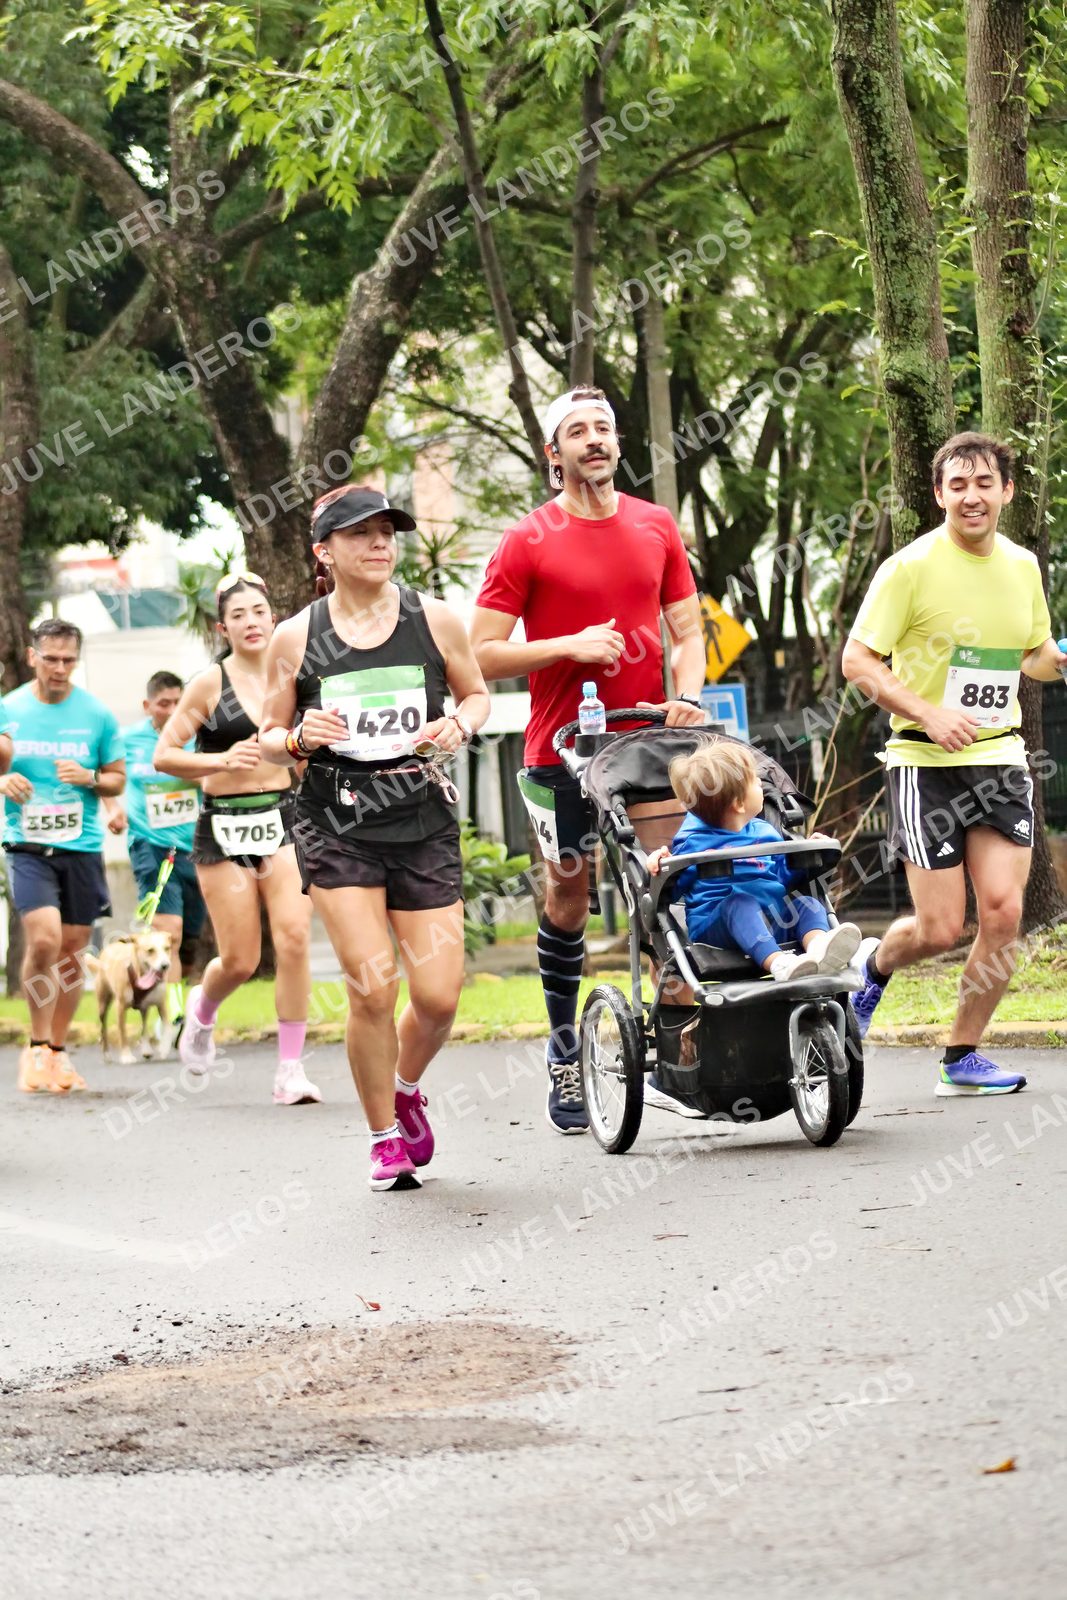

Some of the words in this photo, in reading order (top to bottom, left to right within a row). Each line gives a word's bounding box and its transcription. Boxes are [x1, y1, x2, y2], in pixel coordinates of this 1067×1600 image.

[960, 683, 1010, 709] 883
[153, 799, 194, 816] 1479
[221, 822, 278, 843] 1705
